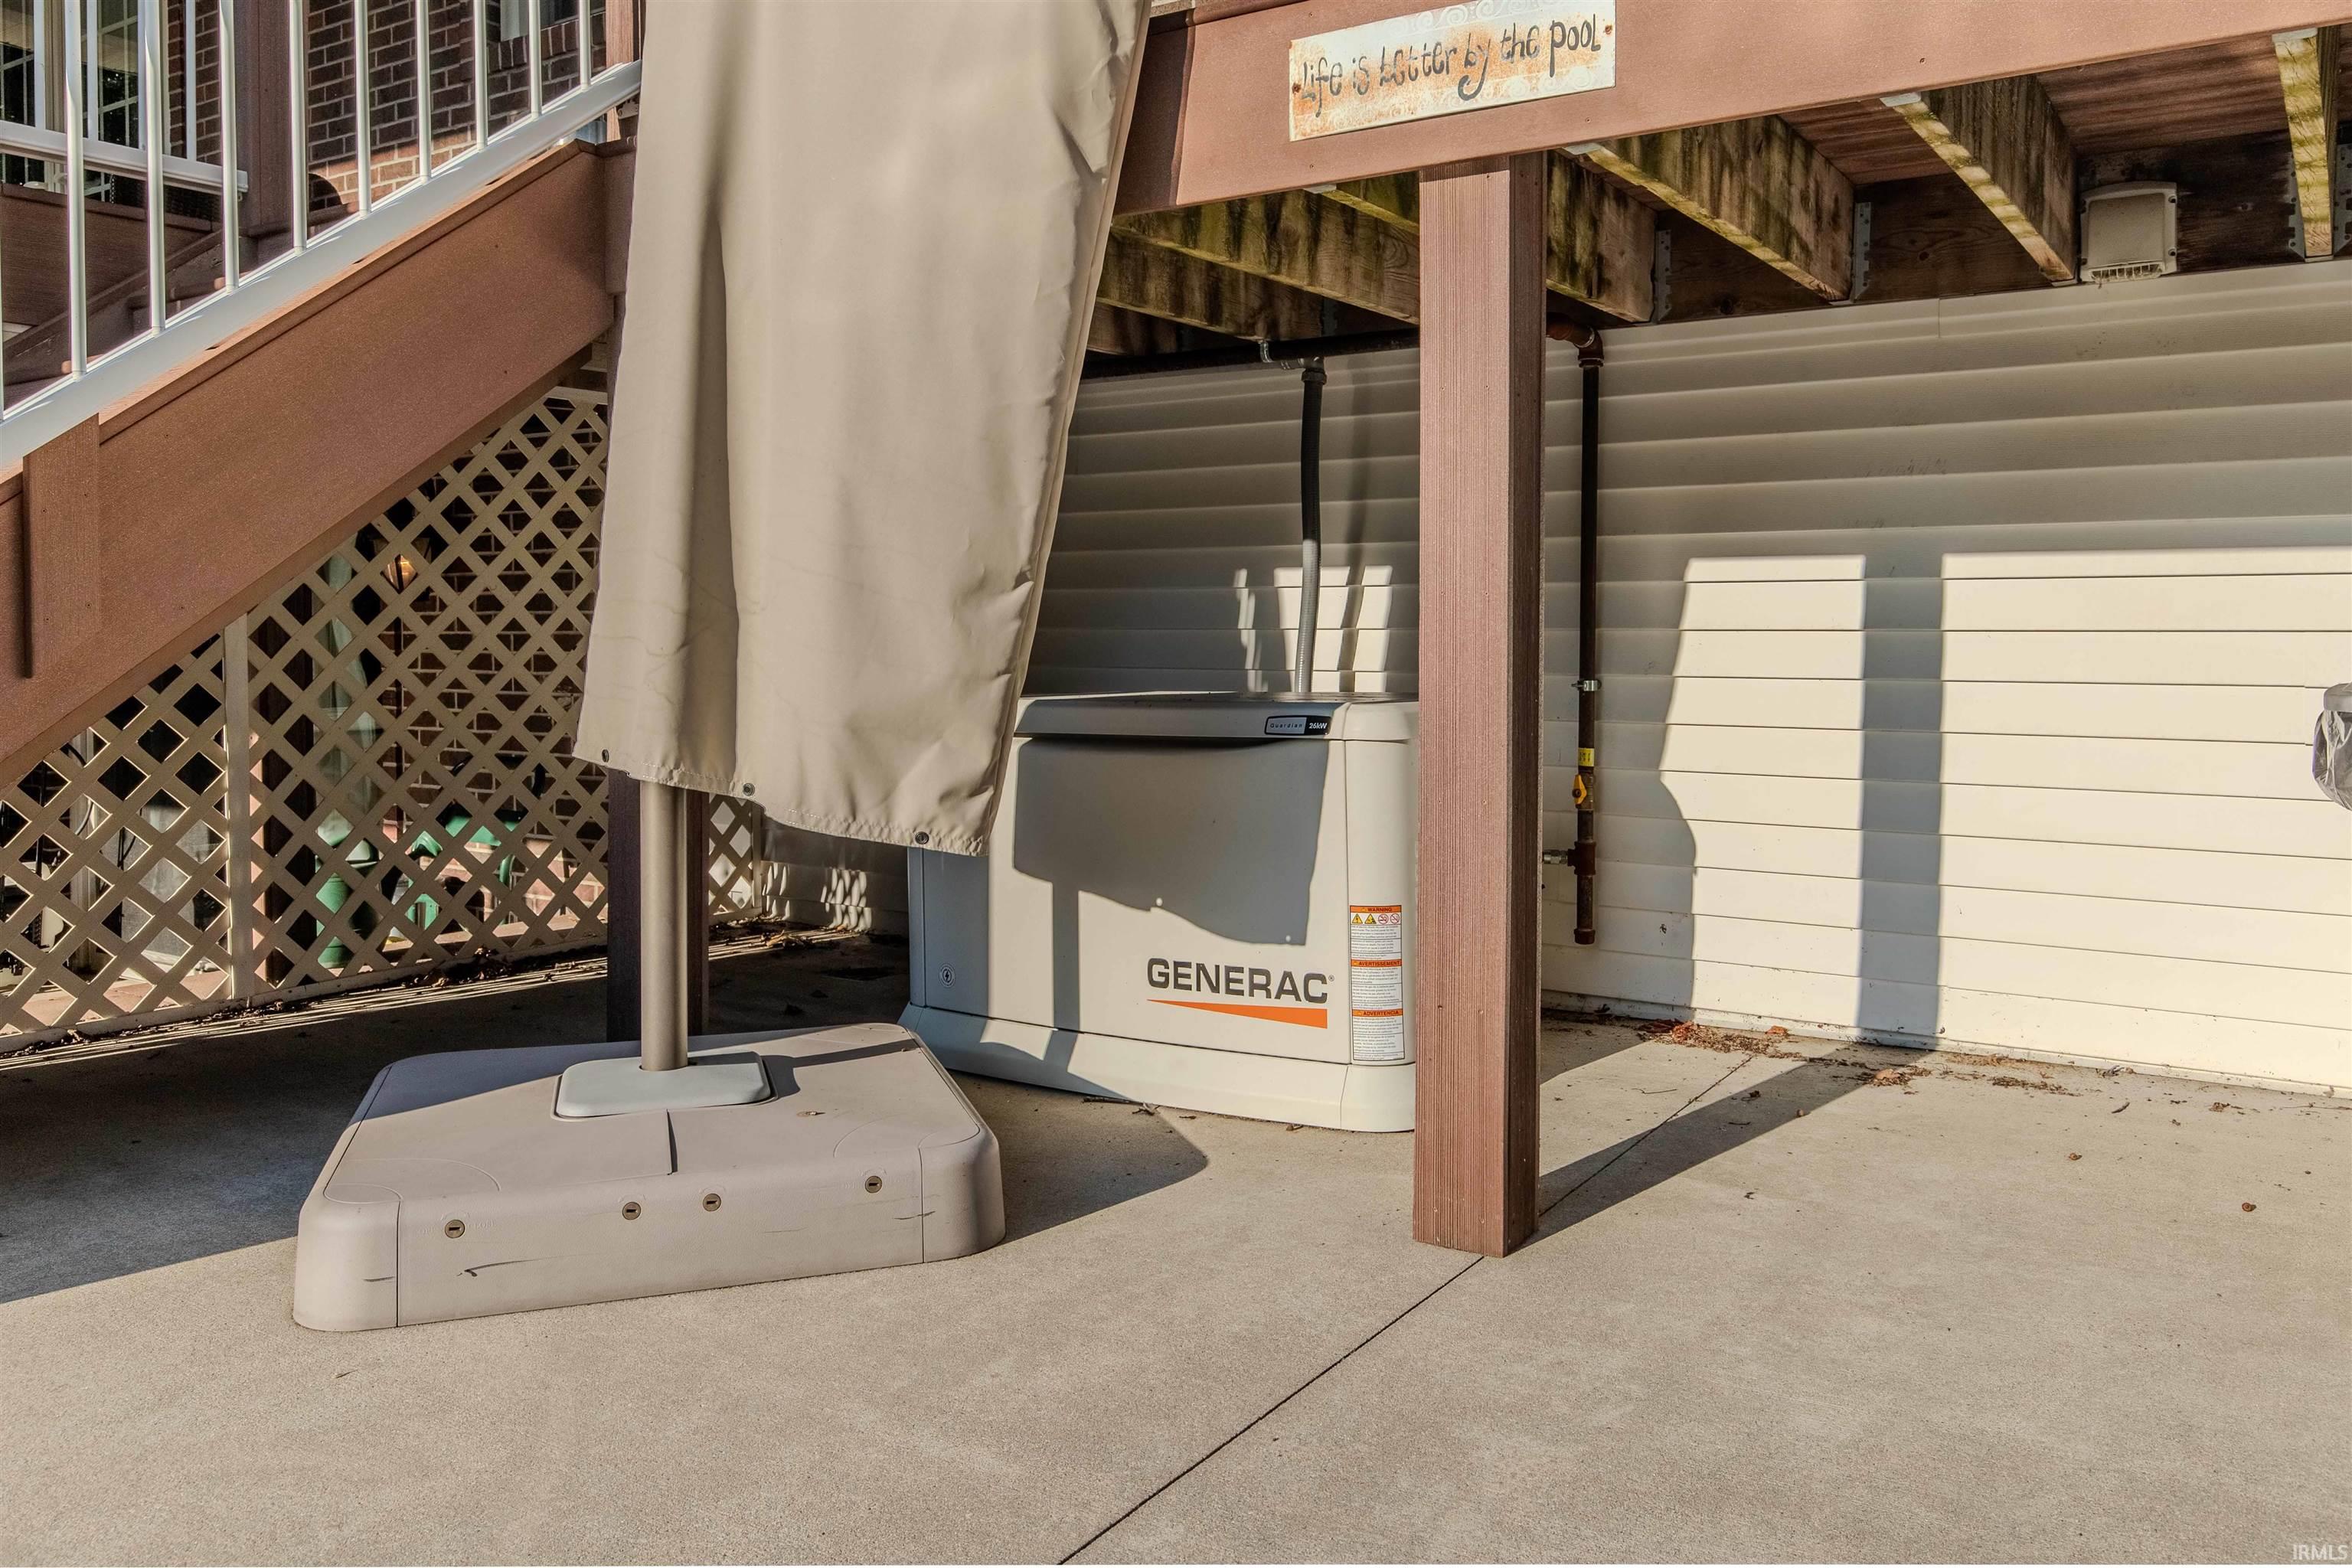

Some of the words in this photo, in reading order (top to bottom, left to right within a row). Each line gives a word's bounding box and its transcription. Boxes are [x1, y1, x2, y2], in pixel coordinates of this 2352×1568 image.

[1352, 55, 1370, 96] is
[1379, 42, 1458, 87] better
[1457, 32, 1491, 101] by
[1500, 22, 1540, 64] the
